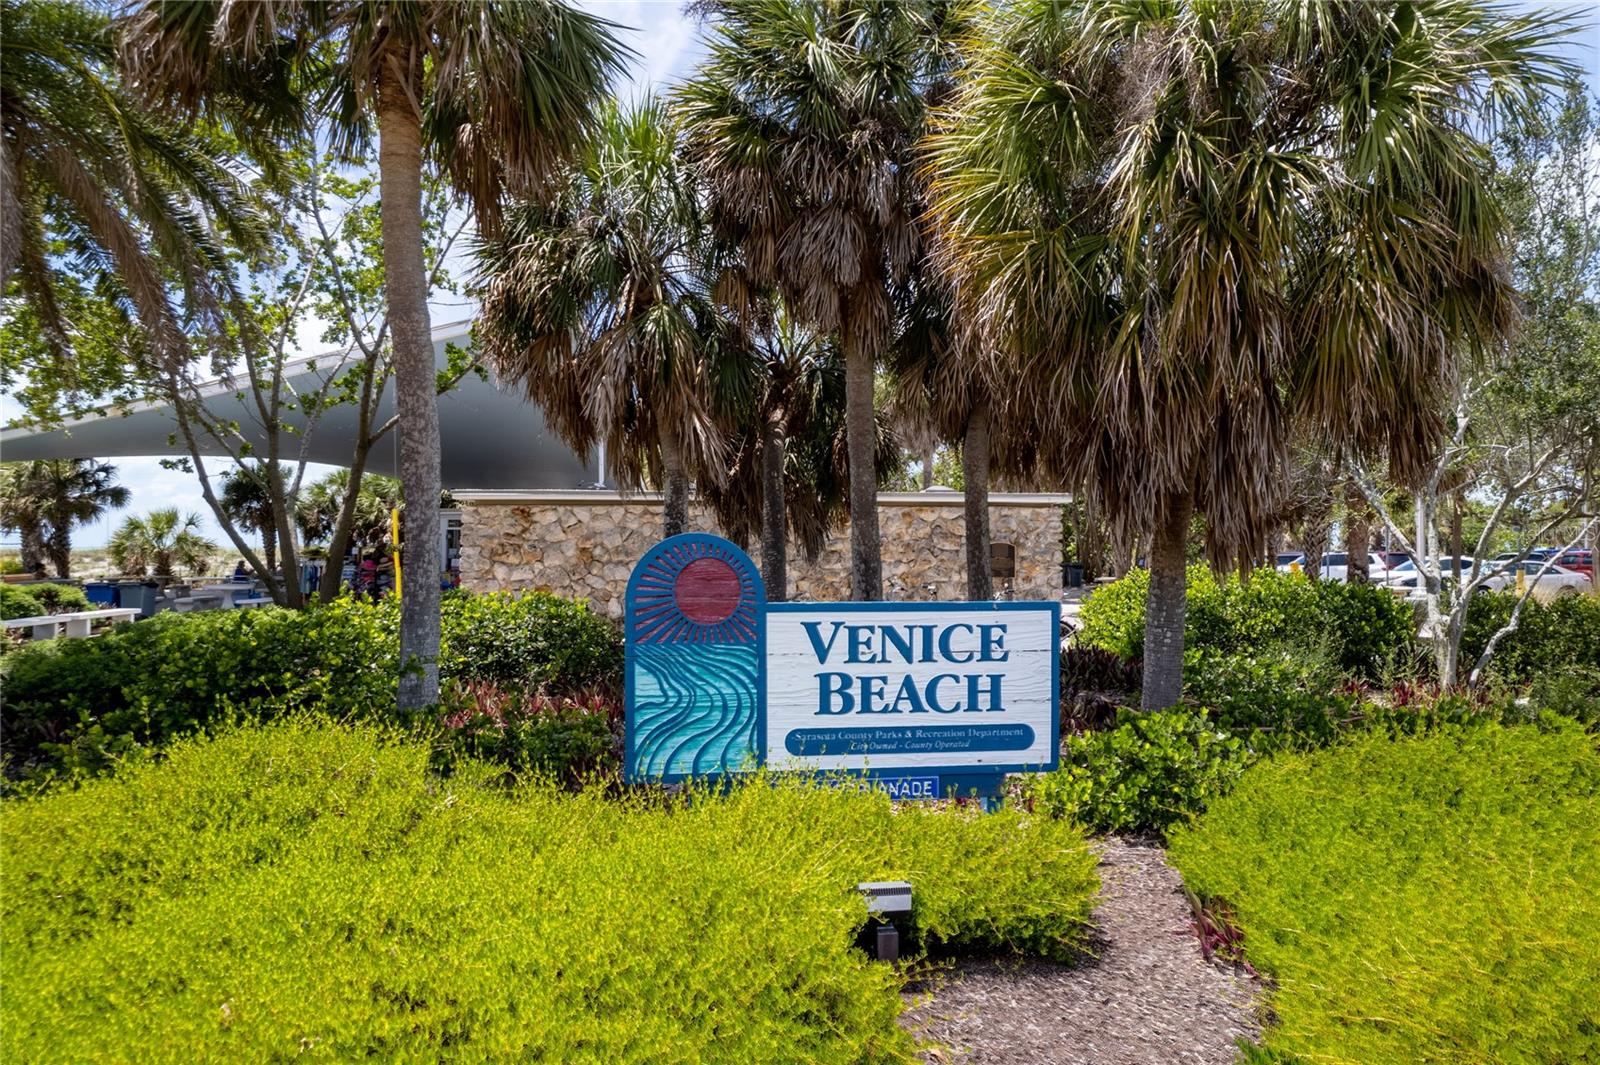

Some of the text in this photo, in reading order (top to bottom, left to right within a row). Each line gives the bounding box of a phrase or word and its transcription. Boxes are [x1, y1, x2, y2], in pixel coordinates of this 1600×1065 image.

[800, 621, 1009, 665] VENICE
[814, 672, 1006, 715] BEACH
[795, 728, 1023, 742] Sarasota County Parks & Recreation Department
[869, 741, 897, 750] Owned
[905, 740, 933, 751] County
[934, 740, 971, 751] Operated
